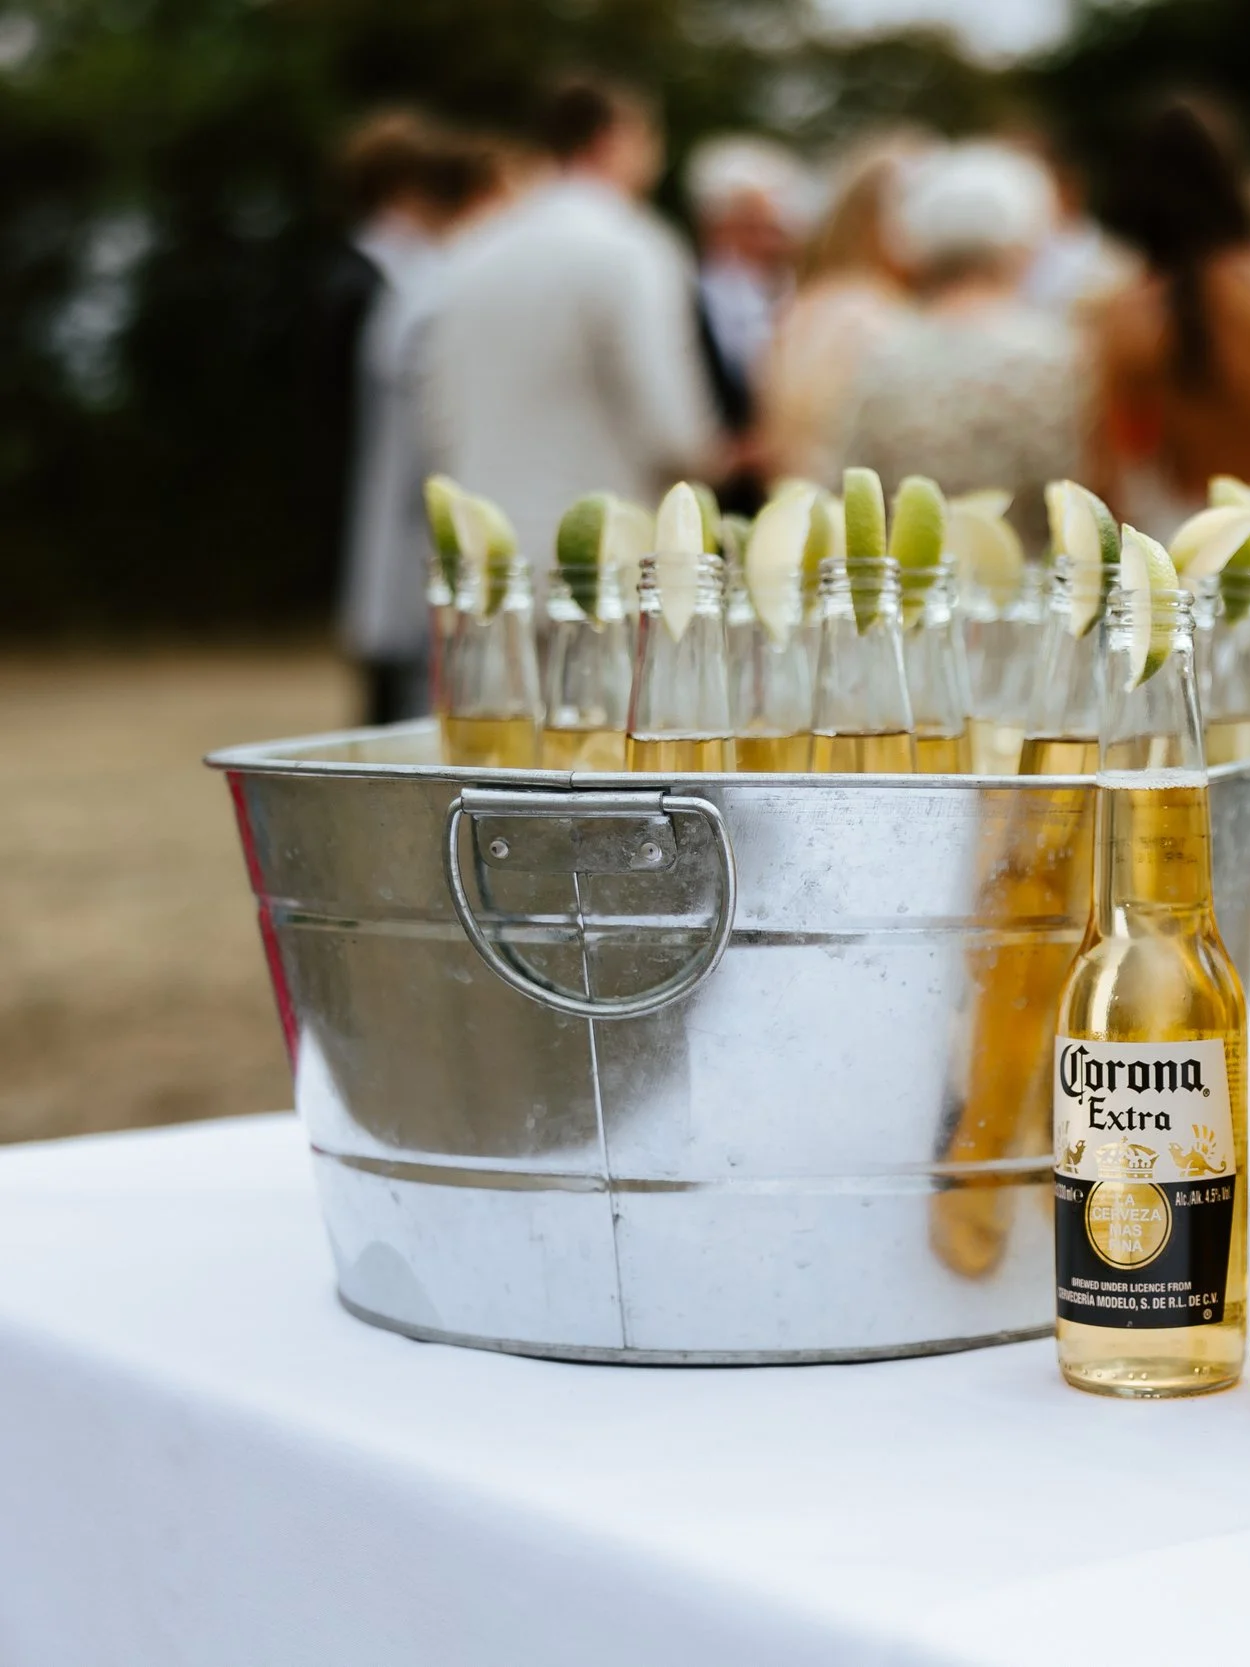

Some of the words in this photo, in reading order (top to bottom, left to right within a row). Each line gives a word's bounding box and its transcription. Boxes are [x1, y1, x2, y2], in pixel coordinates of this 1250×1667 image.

[1060, 1044, 1205, 1105] Corona
[1088, 1096, 1171, 1131] Extra
[1114, 1193, 1135, 1206] LA
[1093, 1207, 1161, 1222] CERVEZA
[1110, 1224, 1143, 1237] MAS
[1109, 1238, 1143, 1252] FINA
[1072, 1277, 1099, 1290] BREWED
[1101, 1282, 1128, 1292] UNDER
[1130, 1283, 1166, 1293] LICENCE
[1167, 1281, 1192, 1291] FROM
[1096, 1295, 1138, 1311] MODELO,
[1141, 1297, 1150, 1309] S.
[1153, 1297, 1166, 1308] DE
[1168, 1296, 1186, 1308] R.L.
[1189, 1295, 1201, 1307] DE
[1203, 1292, 1218, 1305] C.V.
